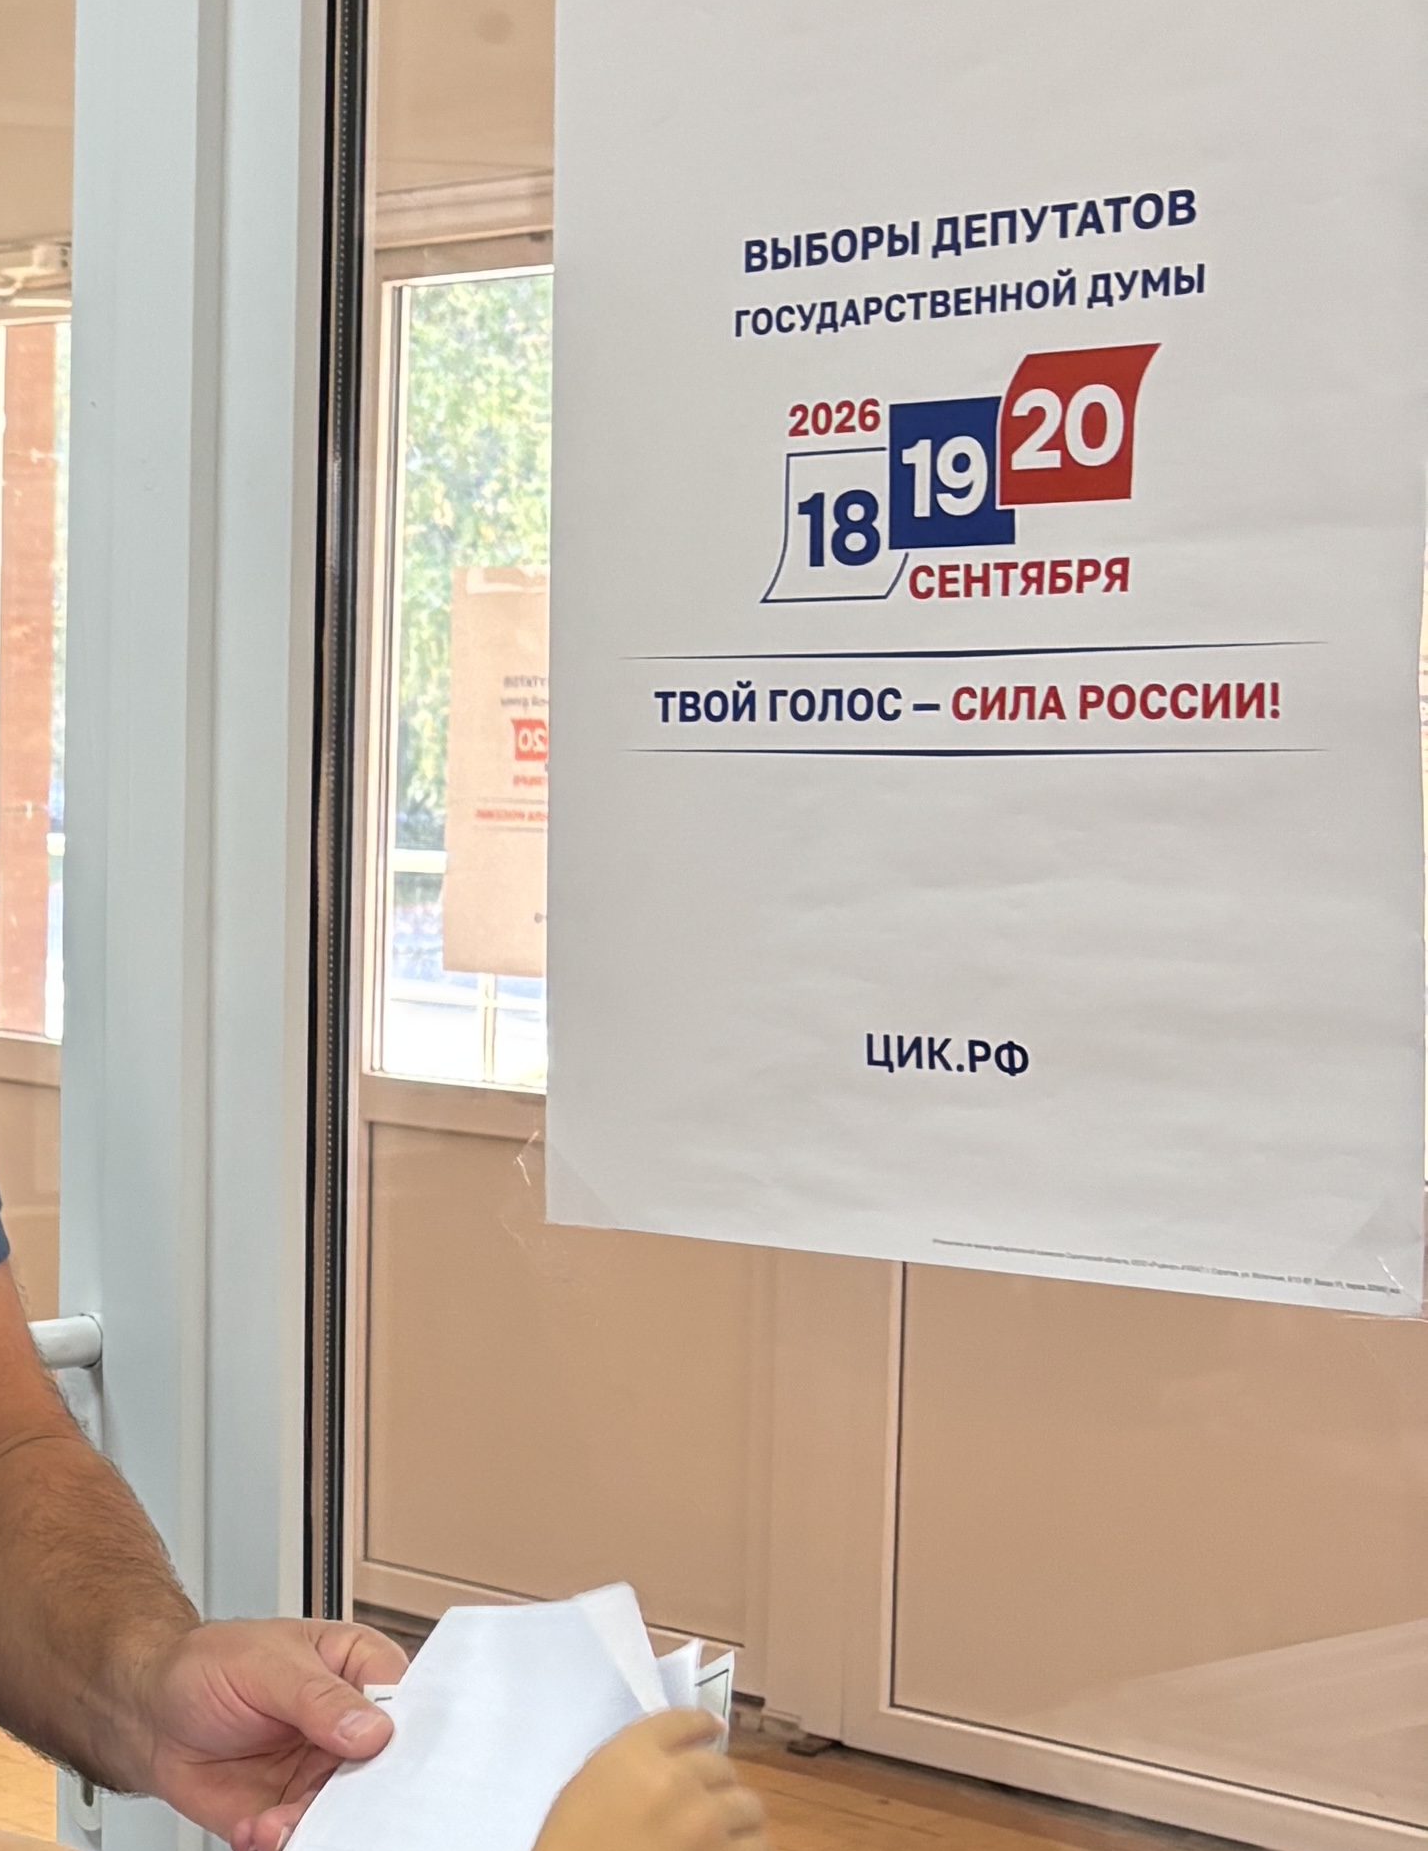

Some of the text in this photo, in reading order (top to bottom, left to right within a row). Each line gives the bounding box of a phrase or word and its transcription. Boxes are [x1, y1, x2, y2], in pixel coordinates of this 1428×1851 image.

[743, 188, 1197, 273] ВЫБОРЫ ДЕПУТАТОВ
[734, 264, 1206, 338] ГОСУДАРСТВЕННОЙ ДУМЫ
[787, 397, 881, 437] 2026
[796, 383, 1125, 568] 18 19 20
[908, 556, 1130, 600] СЕНТЯБРЯ
[655, 681, 756, 723] ТВОЙ
[768, 686, 902, 722] ГОЛОС
[951, 685, 1066, 722] СИЛА
[1078, 682, 1281, 720] РОССИИ!
[865, 1032, 1030, 1077] ЦИК.РФ
